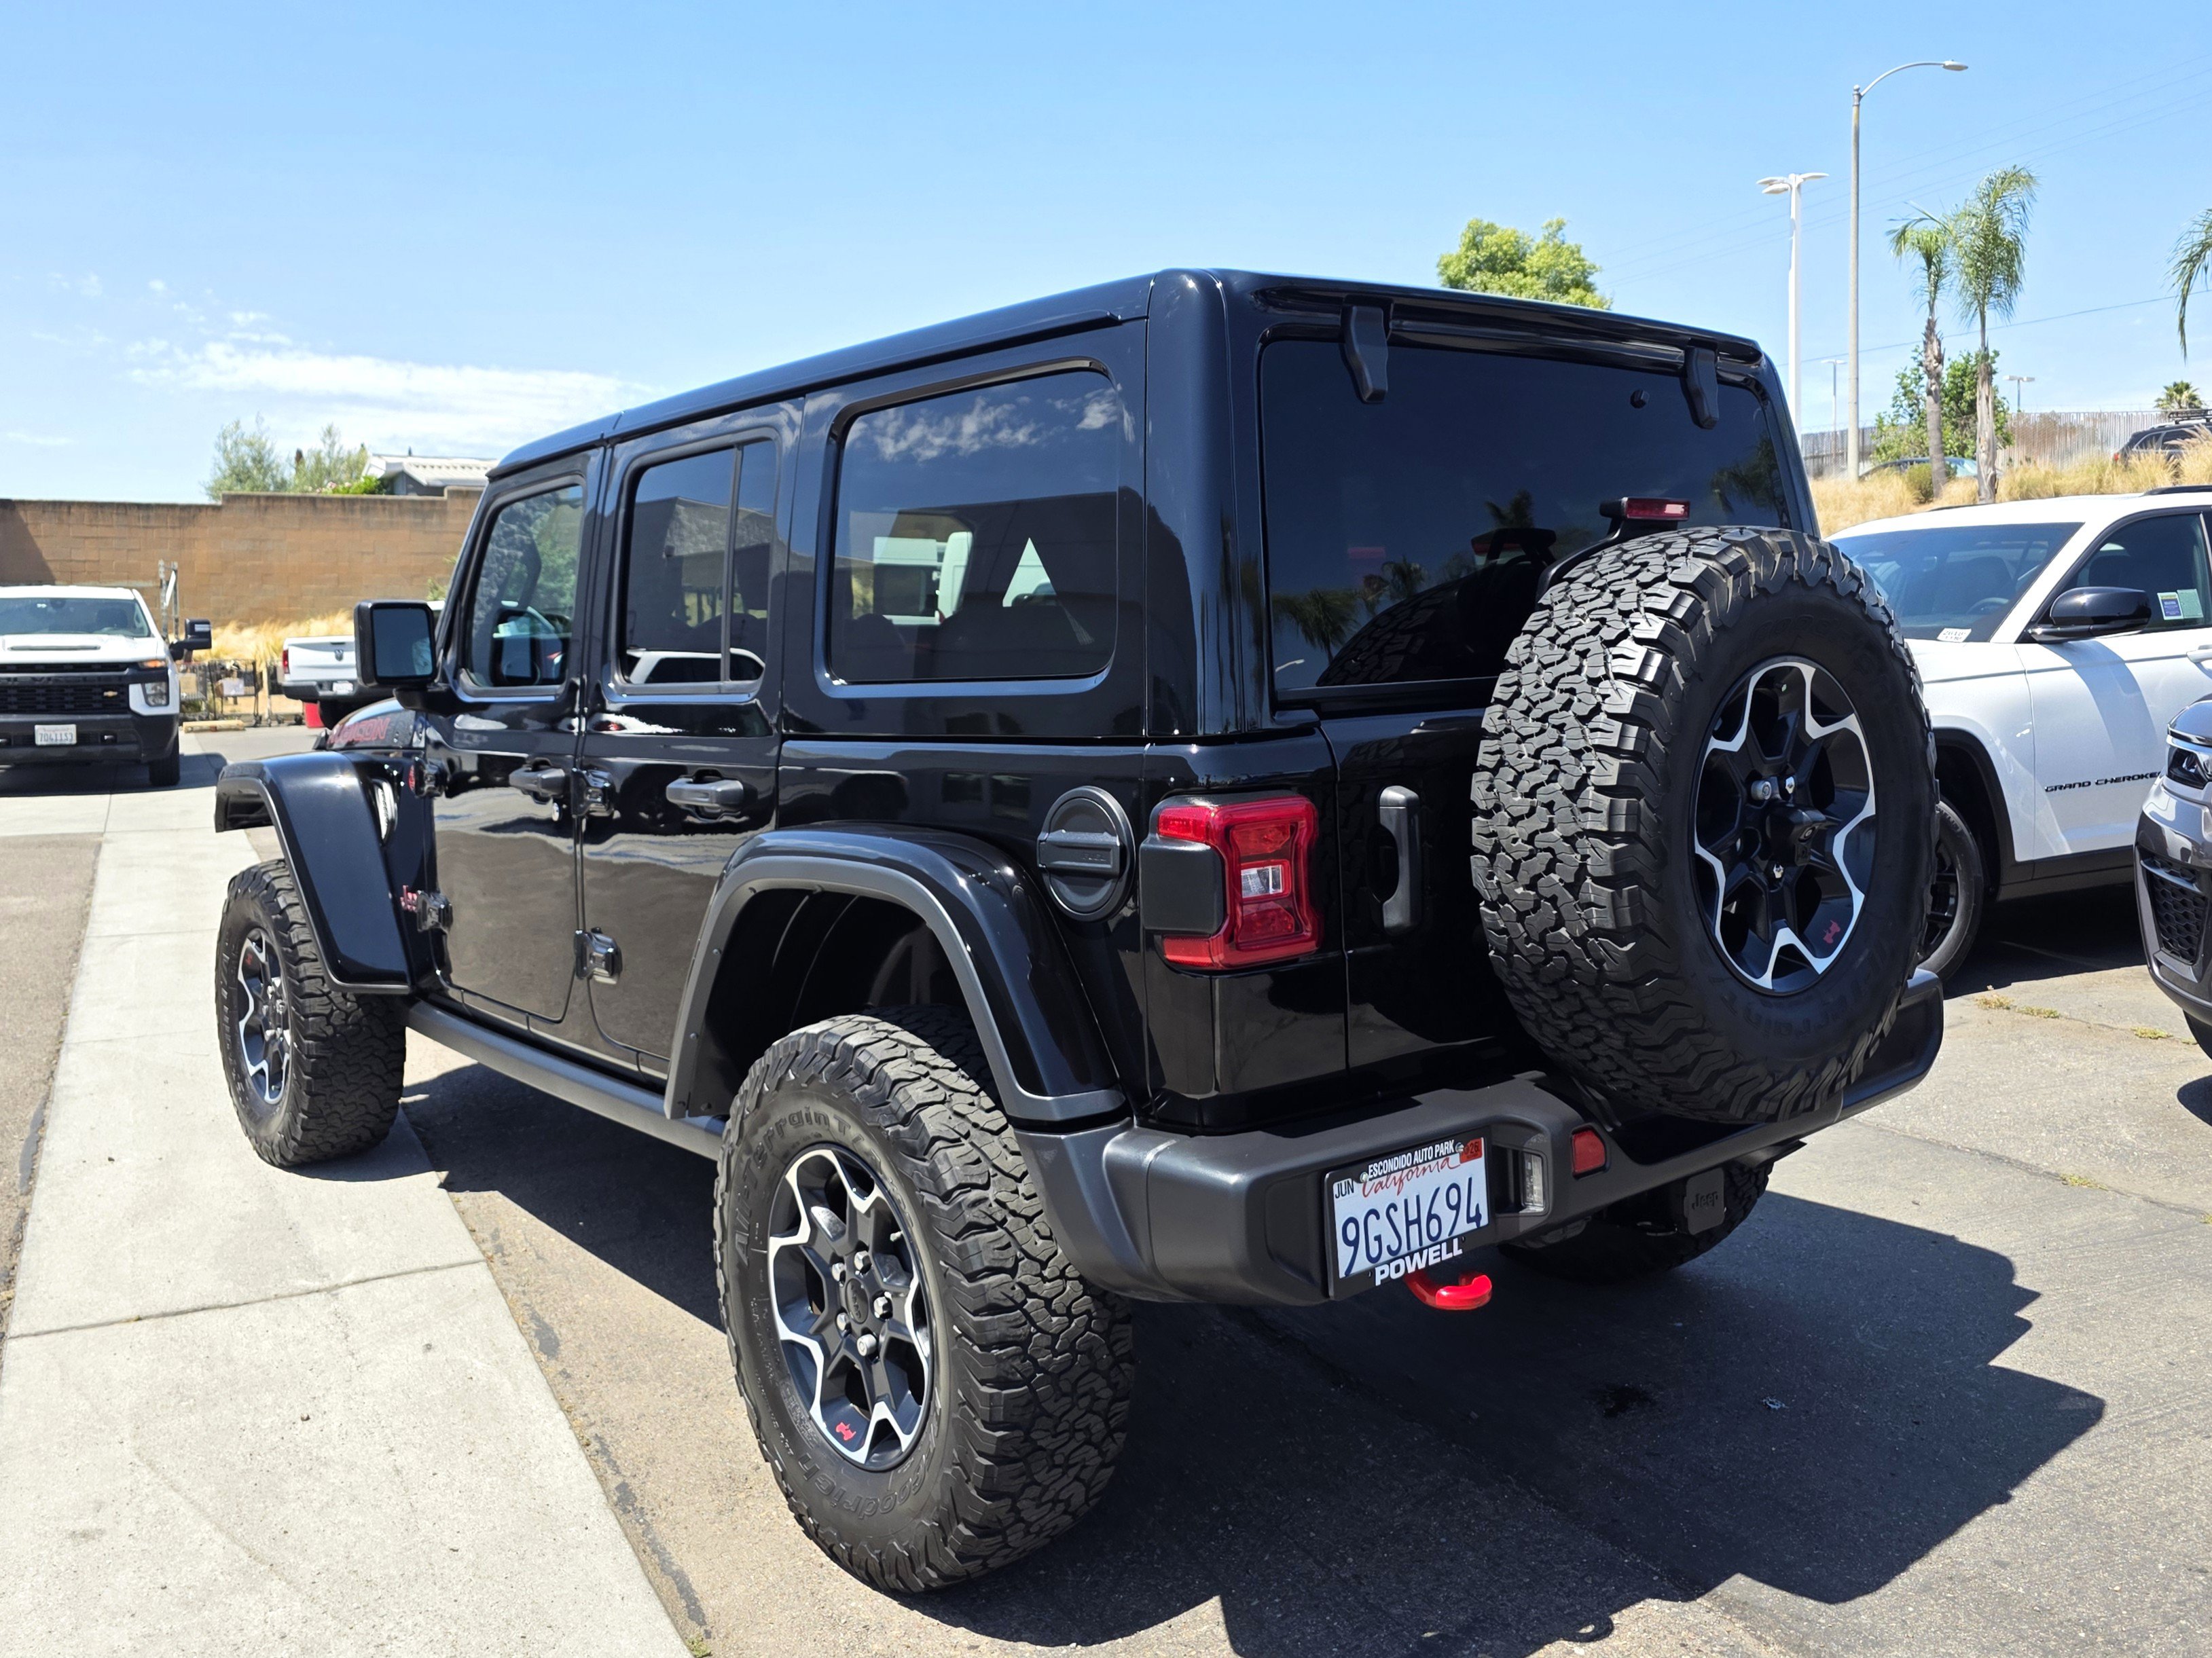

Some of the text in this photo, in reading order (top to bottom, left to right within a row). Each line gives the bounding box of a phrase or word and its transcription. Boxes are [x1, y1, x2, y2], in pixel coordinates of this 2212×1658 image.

[2044, 781, 2091, 792] GRAND
[1362, 1156, 1461, 1198] California
[1368, 1139, 1455, 1179] ESCONDIDO AUTO PARK
[1335, 1179, 1354, 1199] JUN
[1341, 1177, 1482, 1277] 9GSH694
[1375, 1238, 1463, 1286] POWELL
